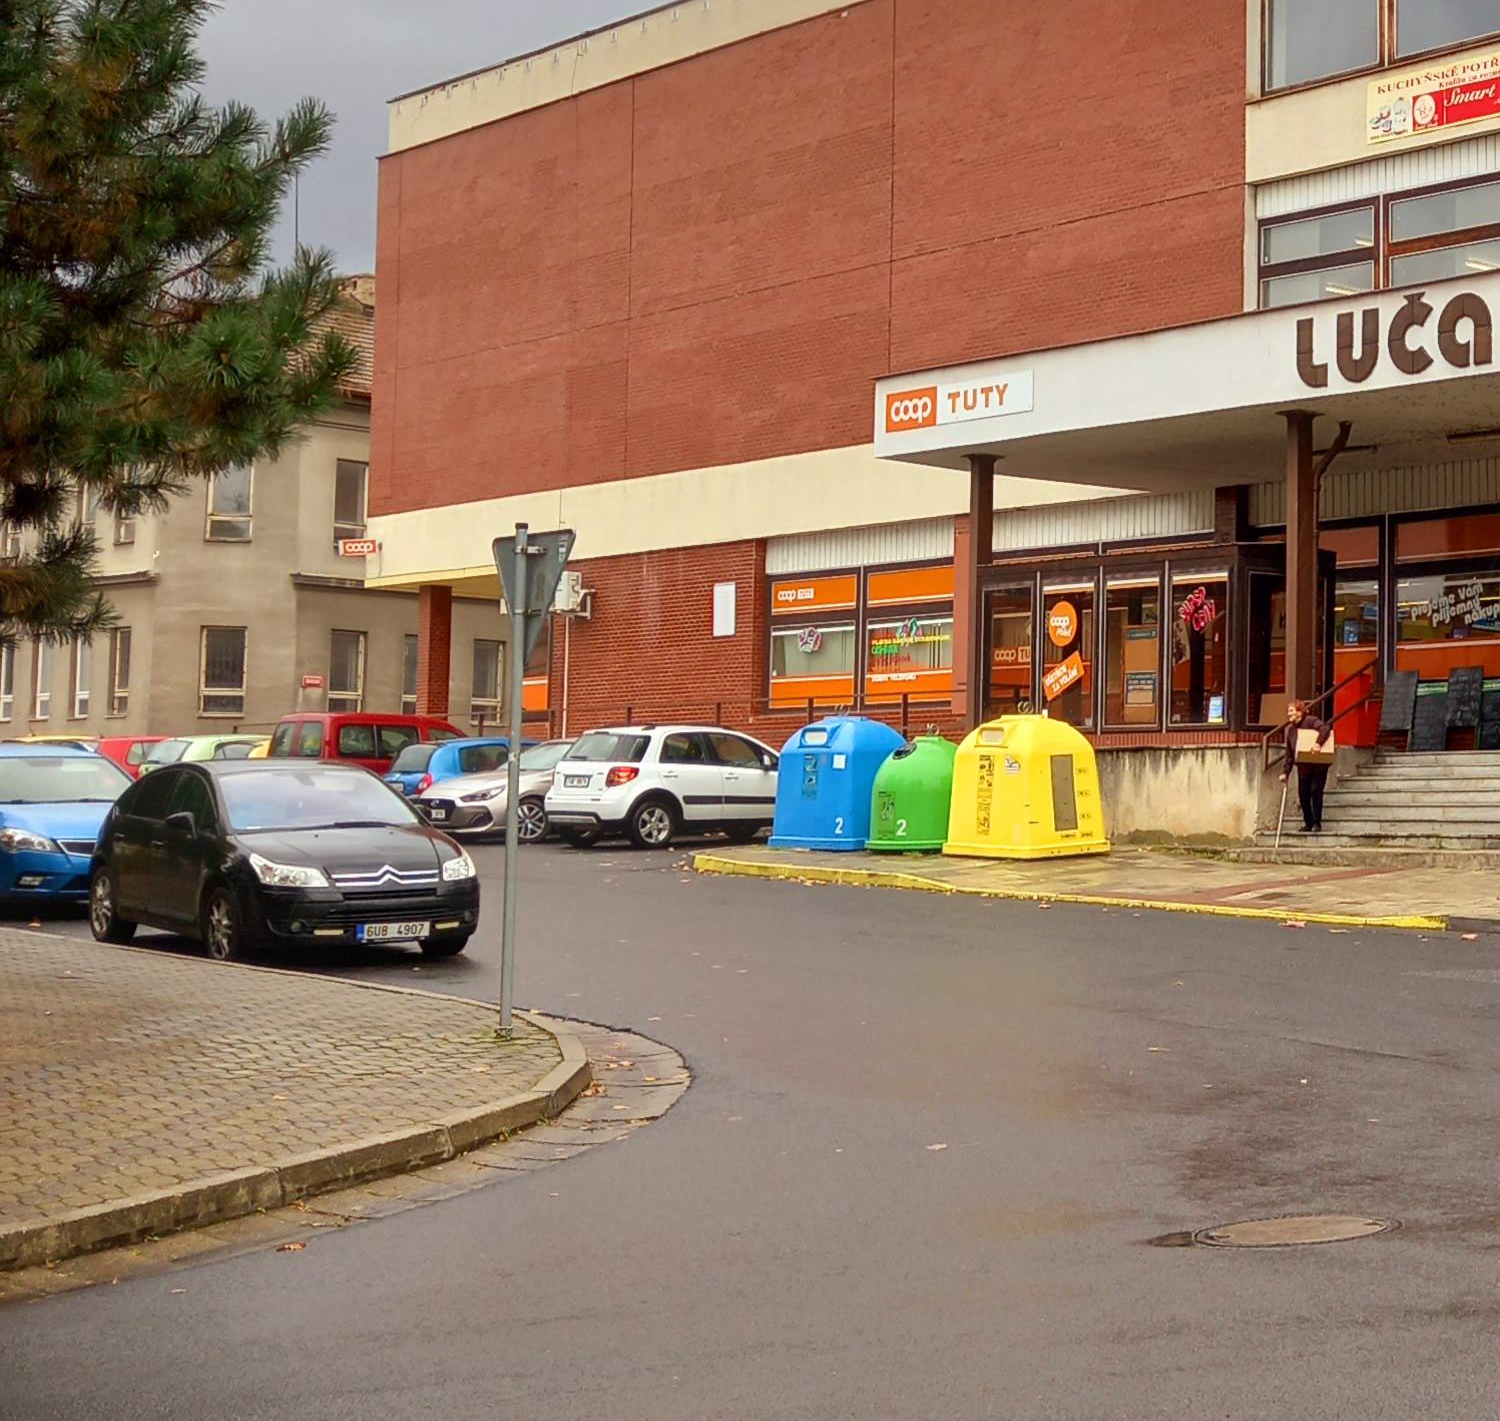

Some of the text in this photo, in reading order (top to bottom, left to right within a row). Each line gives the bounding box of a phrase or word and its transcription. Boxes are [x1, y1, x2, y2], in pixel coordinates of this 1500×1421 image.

[1377, 65, 1458, 95] KUCHYŇSKÉ
[1444, 84, 1497, 107] Smart
[890, 383, 1009, 424] coop TUTY
[344, 542, 374, 555] coop
[1049, 616, 1070, 629] coop
[994, 649, 1017, 664] coop
[834, 817, 844, 835] 2
[896, 818, 908, 836] 2
[366, 923, 425, 938] 6UB 4907
